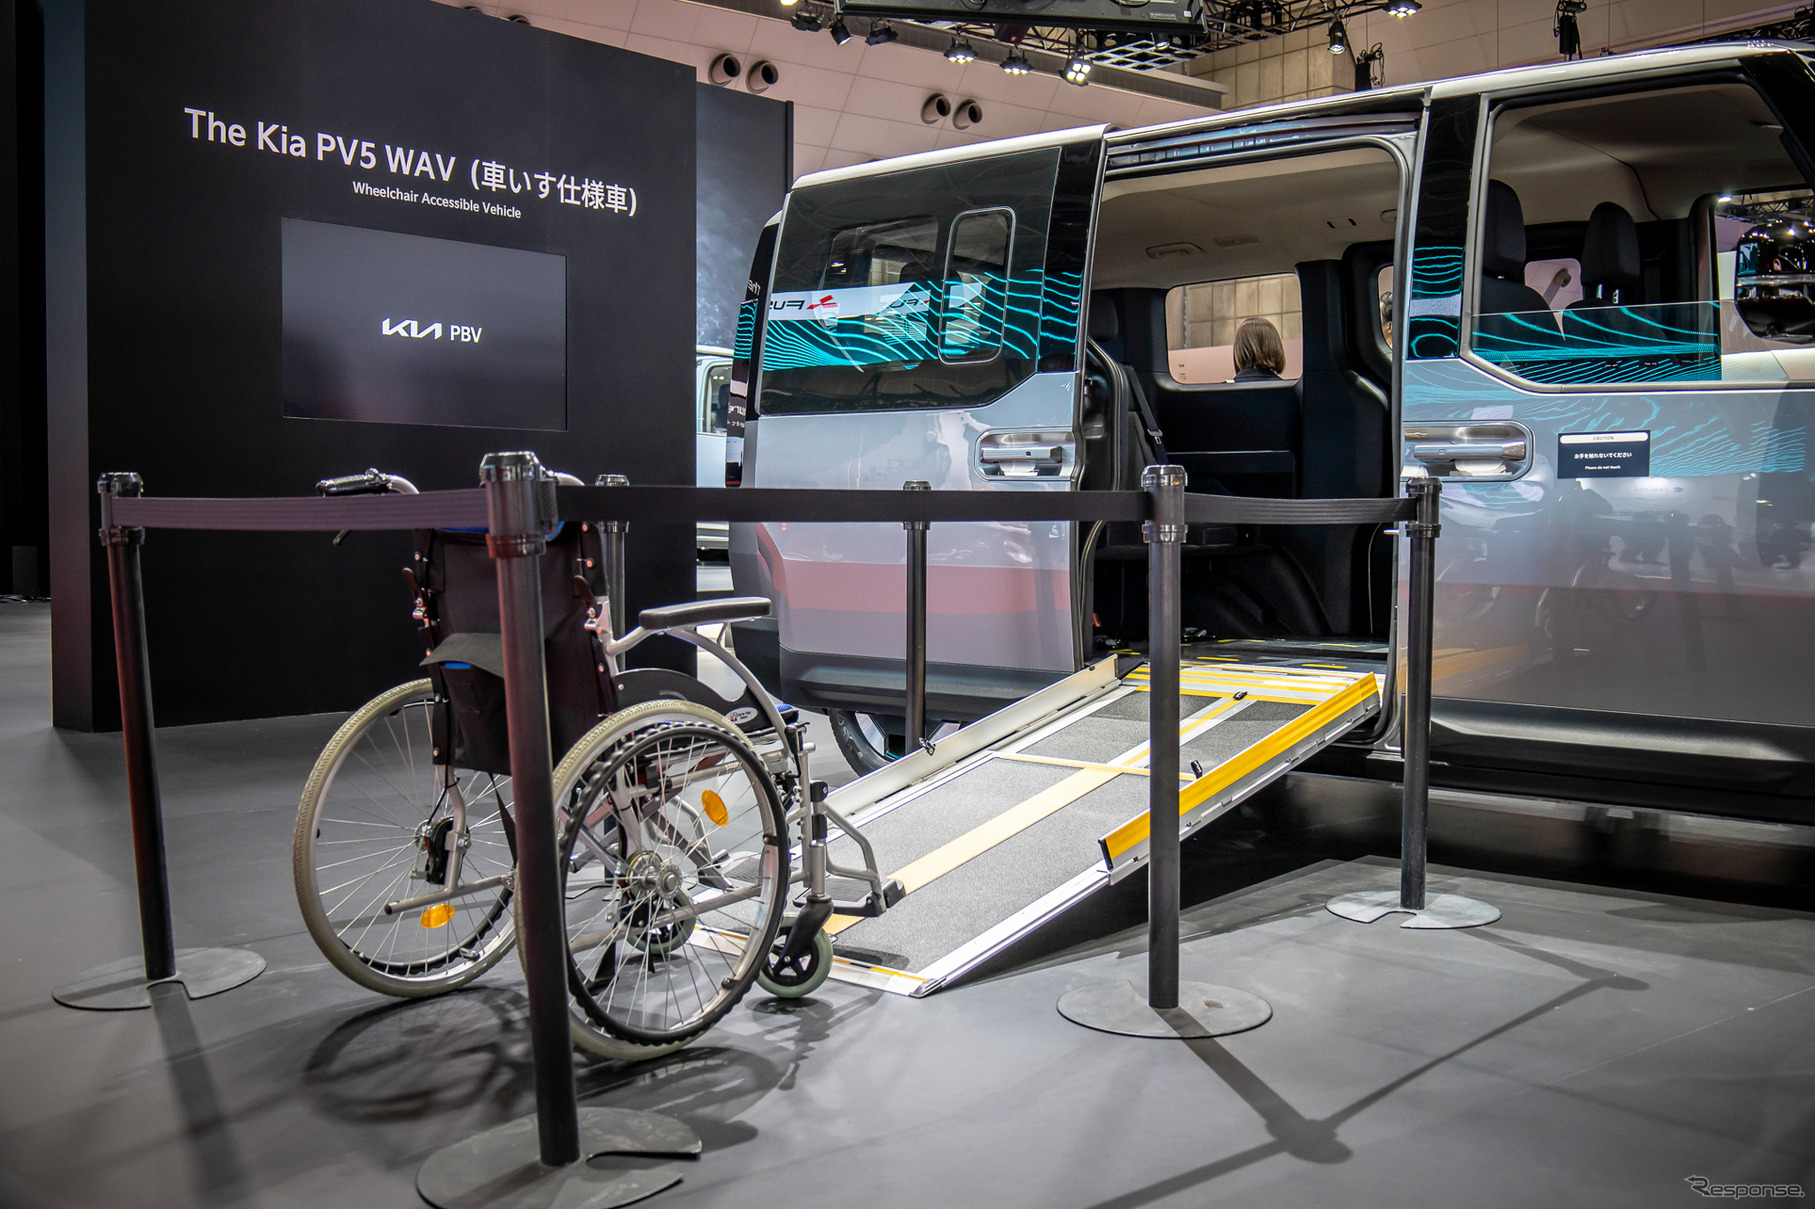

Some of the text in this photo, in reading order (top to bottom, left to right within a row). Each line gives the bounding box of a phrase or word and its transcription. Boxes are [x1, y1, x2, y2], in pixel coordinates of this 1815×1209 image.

[184, 106, 637, 217] The Kia PV5 WAV (車いす仕様車)
[352, 180, 522, 219] Wheelchair Accessible Vehicle
[381, 317, 482, 343] KIA PBV
